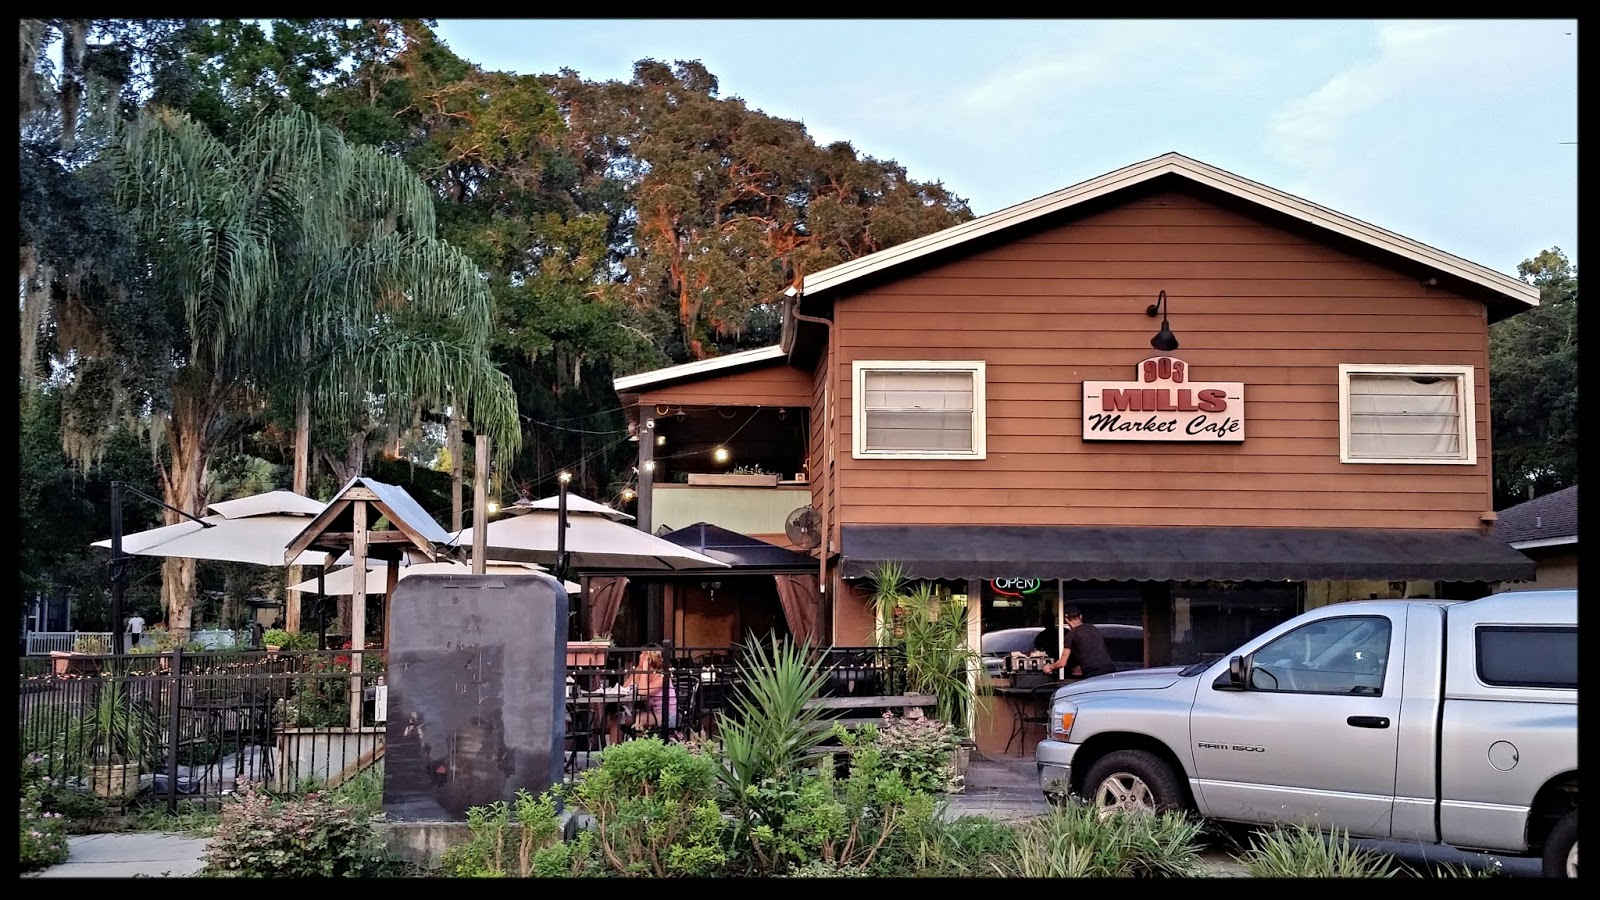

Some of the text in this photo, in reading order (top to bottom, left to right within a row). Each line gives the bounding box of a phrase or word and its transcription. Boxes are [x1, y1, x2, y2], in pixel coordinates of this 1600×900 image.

[1143, 357, 1184, 383] 903
[1102, 388, 1227, 412] MILLS
[1088, 413, 1240, 438] Market Café
[995, 576, 1034, 589] OPEN
[1198, 741, 1265, 753] RAM 1500
